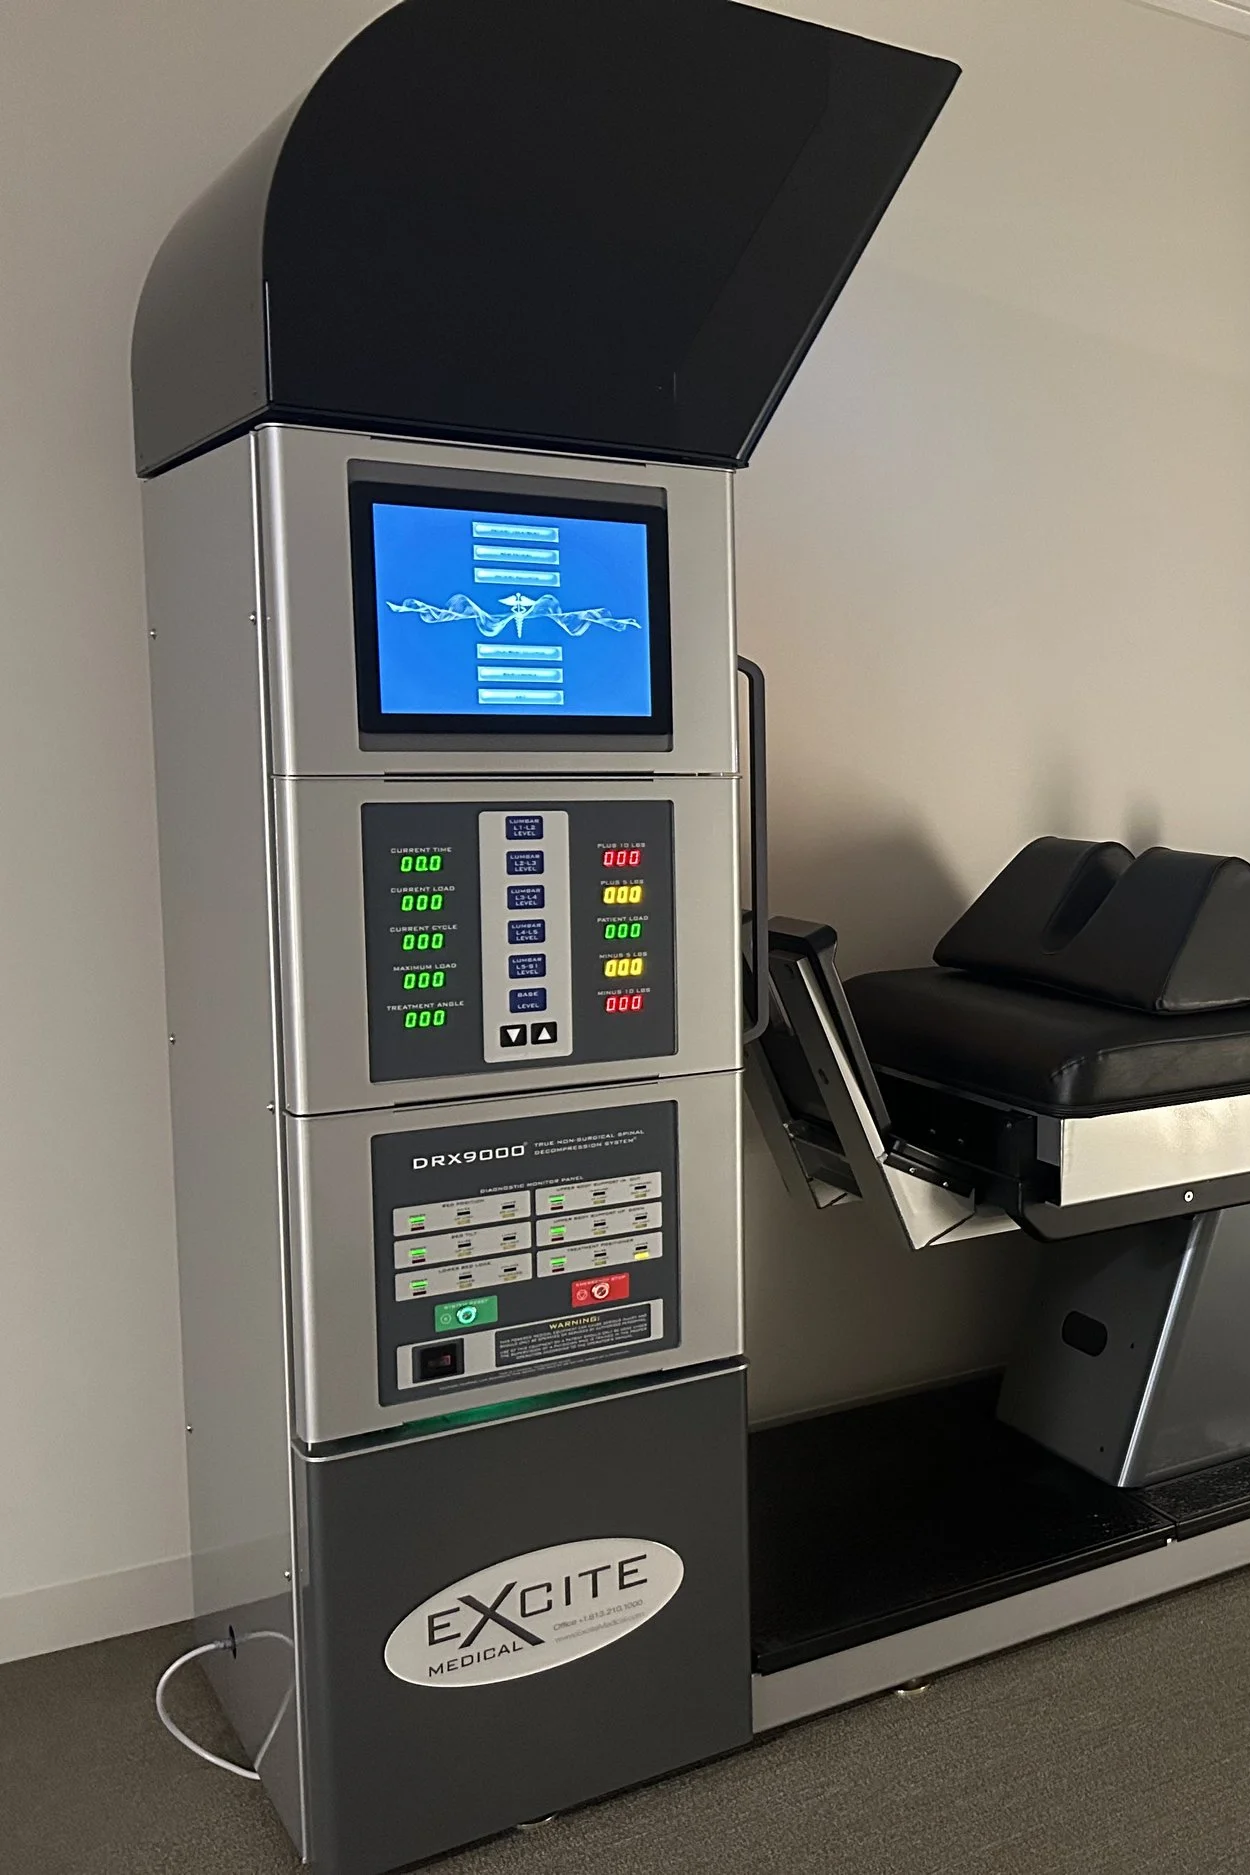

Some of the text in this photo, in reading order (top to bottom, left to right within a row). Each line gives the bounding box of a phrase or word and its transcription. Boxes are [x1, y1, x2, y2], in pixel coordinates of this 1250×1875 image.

[603, 850, 640, 866] 000
[401, 894, 443, 912] 000
[603, 885, 642, 904] 000
[389, 925, 430, 933] CURRENT
[604, 923, 641, 939] 000
[402, 933, 443, 951] 000
[604, 957, 643, 977] 000
[403, 971, 444, 989] 000
[386, 1002, 435, 1011] TREATMENT
[606, 995, 642, 1012] 000
[405, 1009, 445, 1028] 000
[534, 1129, 645, 1148] TRUE NON-SURGICAL SPINAL
[534, 1142, 603, 1155] DECOMPRESSION
[480, 1183, 525, 1194] DIAGNOSTIC
[526, 1178, 559, 1187] MONITOR
[428, 1554, 648, 1649] EXCITE
[428, 1640, 524, 1677] MEDICAL
